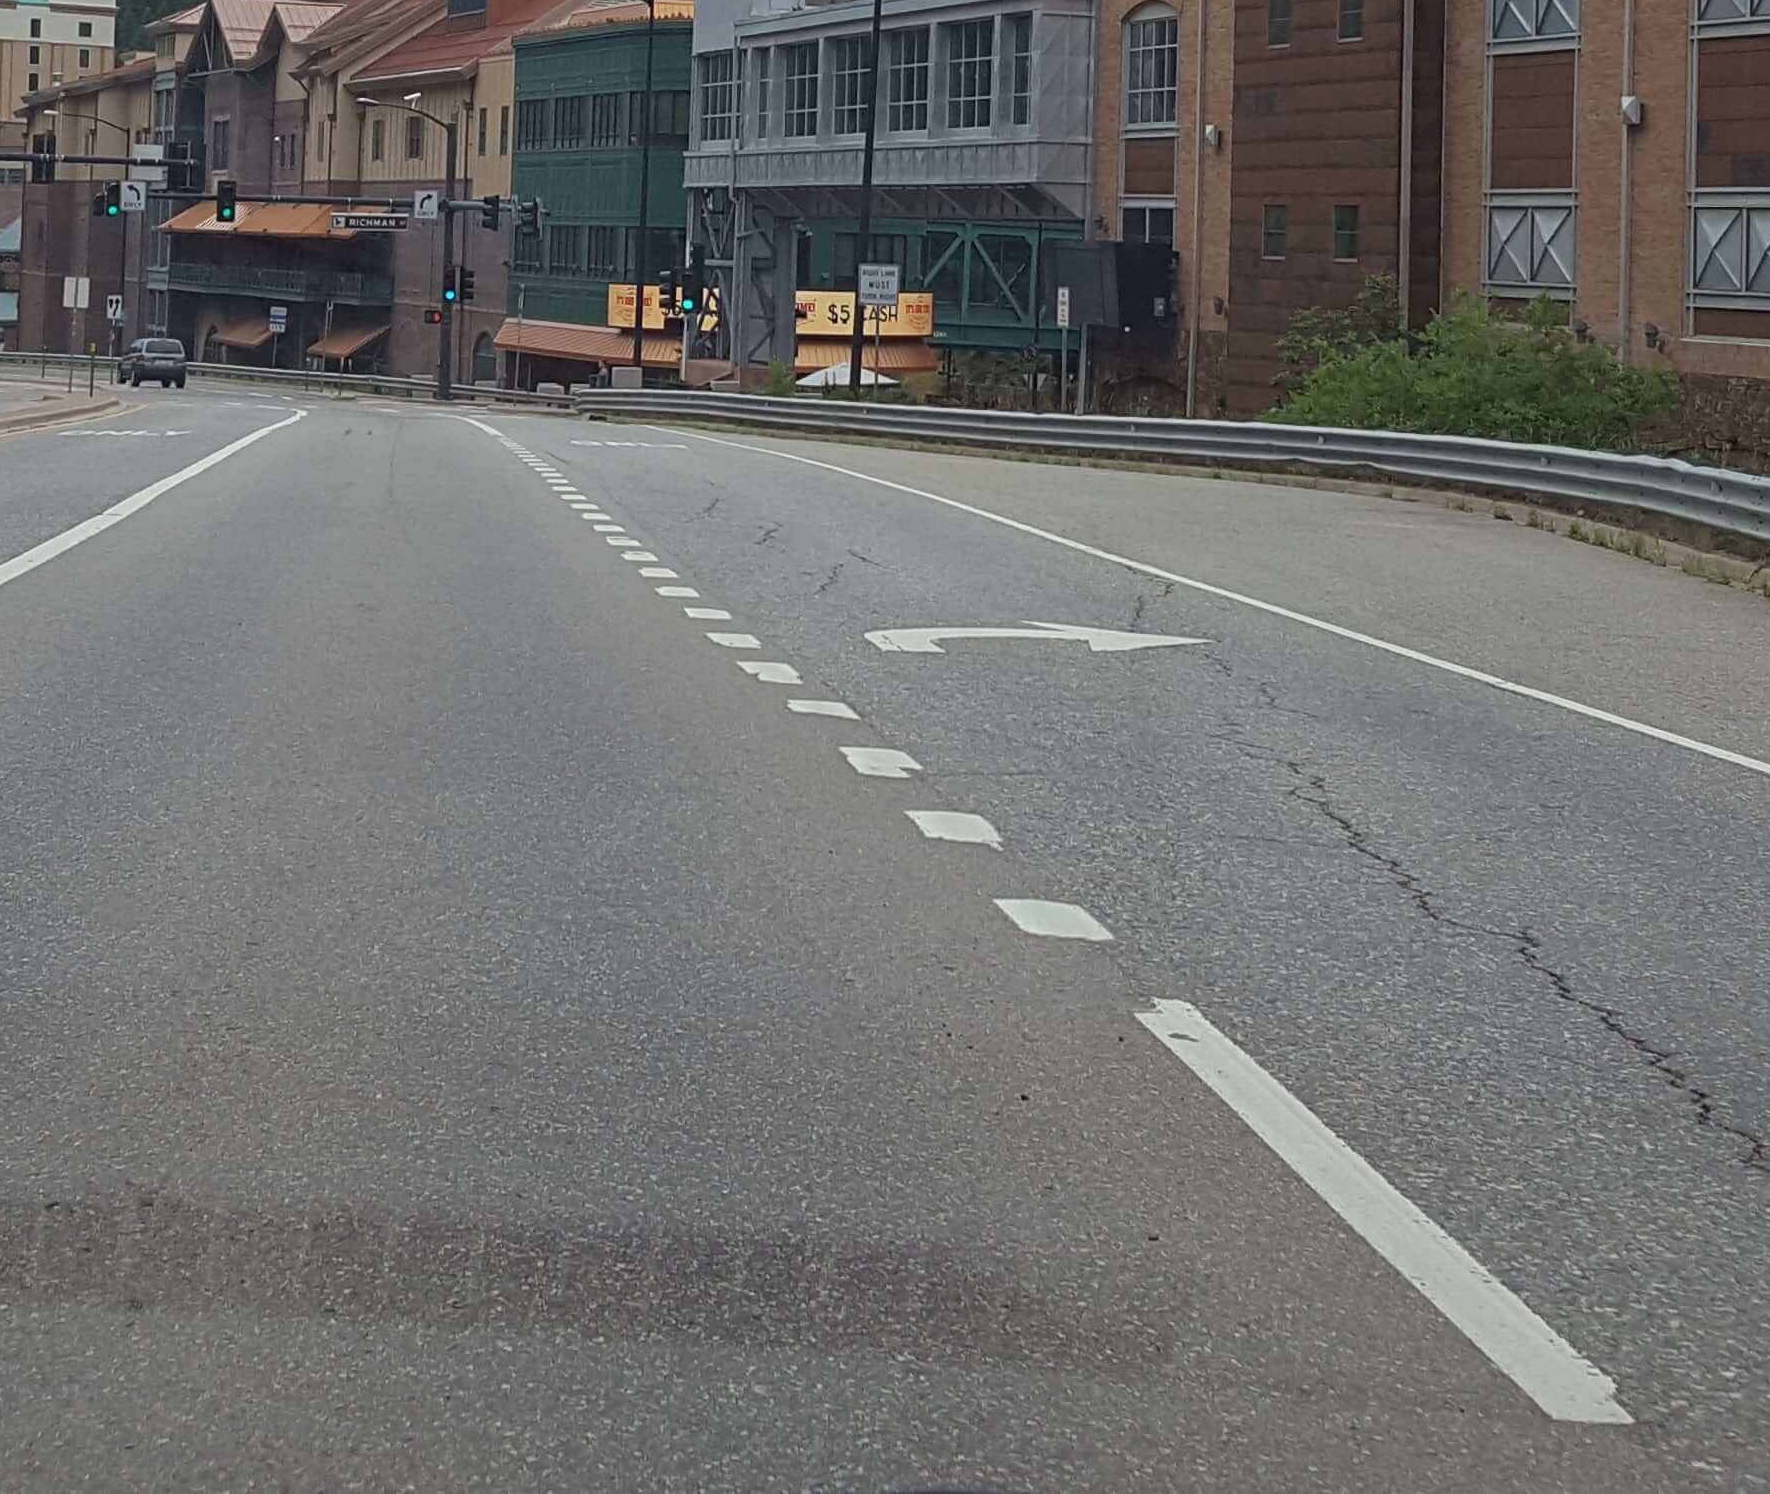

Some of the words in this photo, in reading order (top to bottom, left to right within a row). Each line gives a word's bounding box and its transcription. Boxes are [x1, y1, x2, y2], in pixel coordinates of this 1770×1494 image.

[349, 217, 396, 227] RICHMAN
[869, 281, 890, 290] MUST
[828, 303, 851, 323] $5
